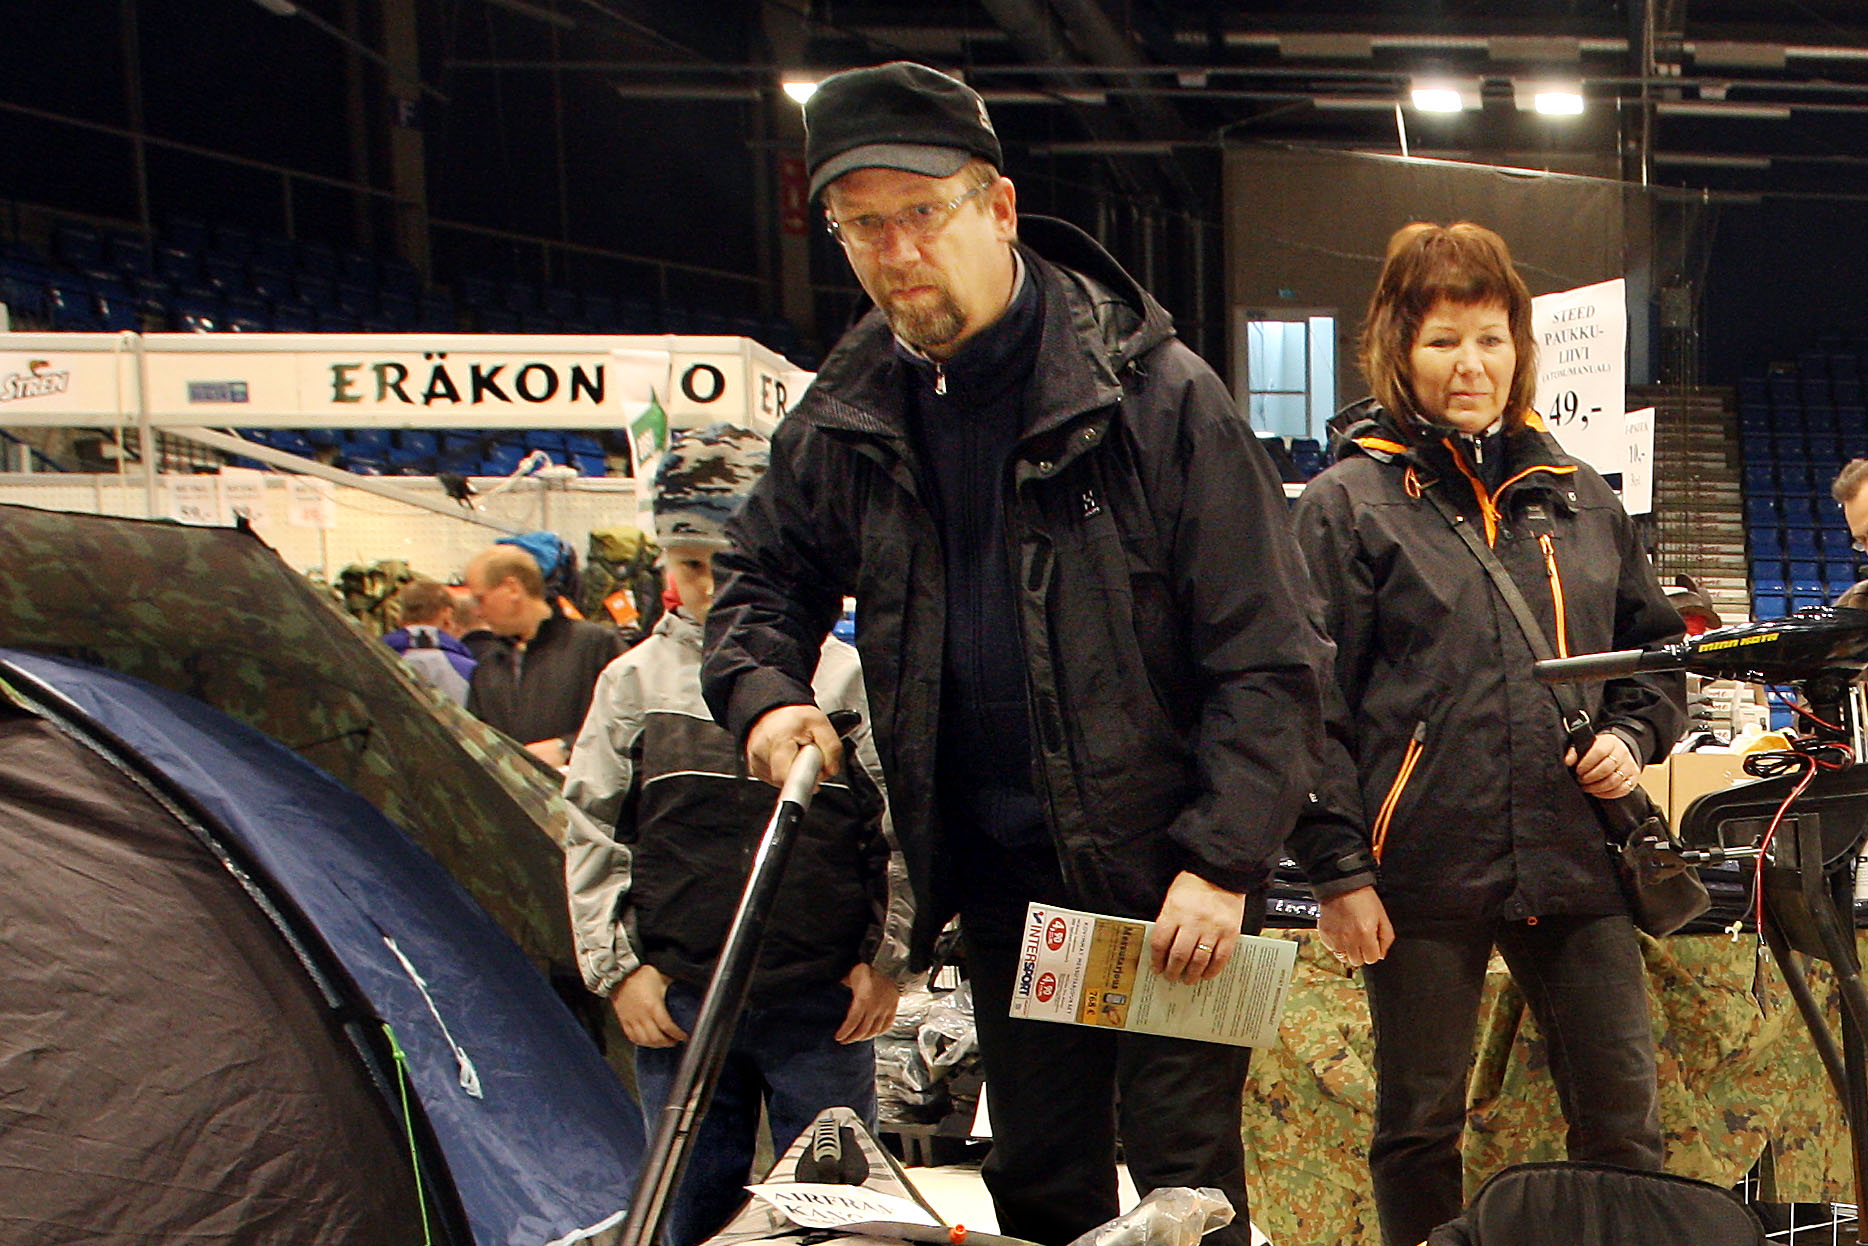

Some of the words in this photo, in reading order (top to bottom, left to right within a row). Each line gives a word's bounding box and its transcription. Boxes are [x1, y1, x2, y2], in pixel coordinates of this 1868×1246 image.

[1552, 305, 1596, 324] STEED
[1544, 325, 1604, 346] PAUKKU-
[1559, 347, 1590, 364] LIIVI
[1549, 390, 1603, 431] 49,-
[1019, 924, 1042, 996] INTERSPORT
